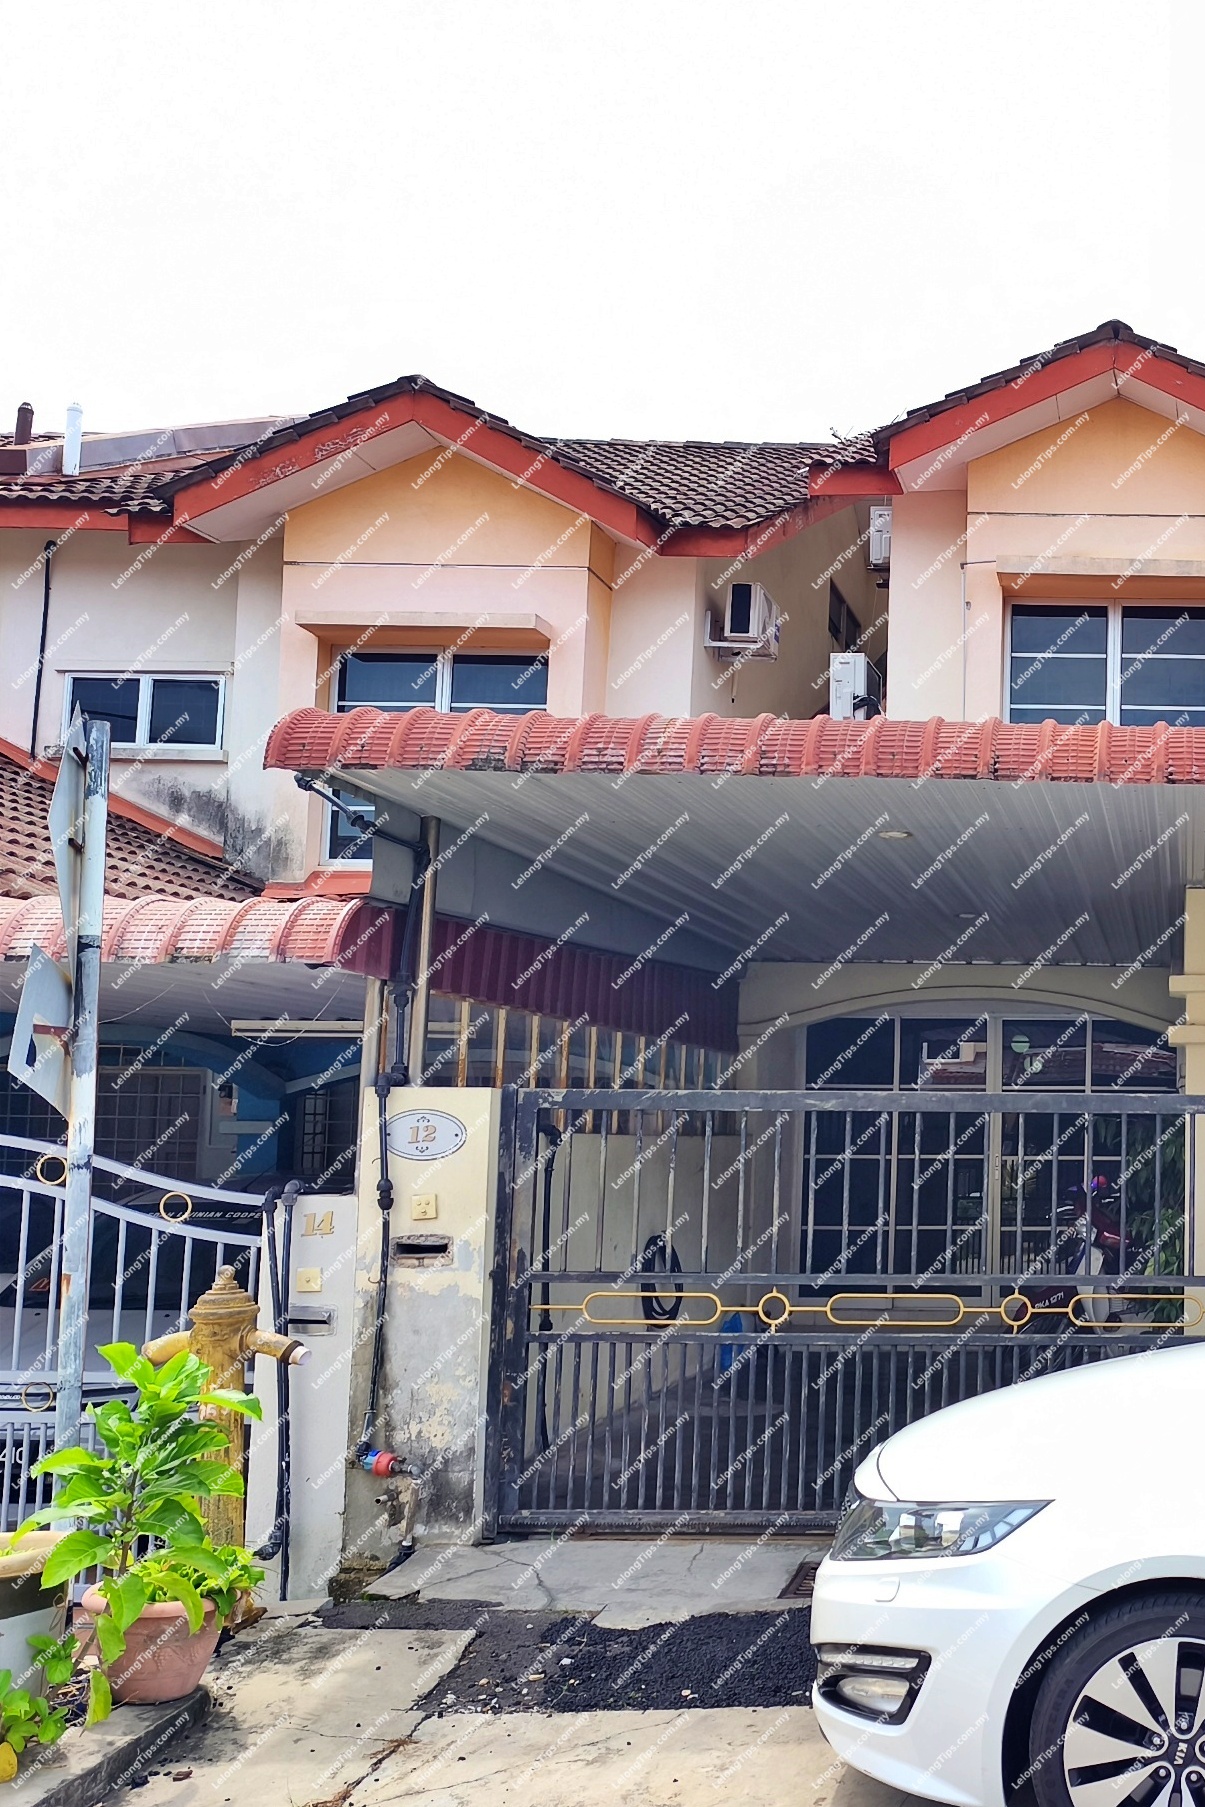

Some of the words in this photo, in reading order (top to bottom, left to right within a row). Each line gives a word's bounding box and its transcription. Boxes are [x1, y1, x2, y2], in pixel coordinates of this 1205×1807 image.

[407, 1124, 437, 1144] 12
[225, 1211, 263, 1219] COOPE
[301, 1211, 335, 1237] 14
[1173, 1742, 1188, 1765] KIA
